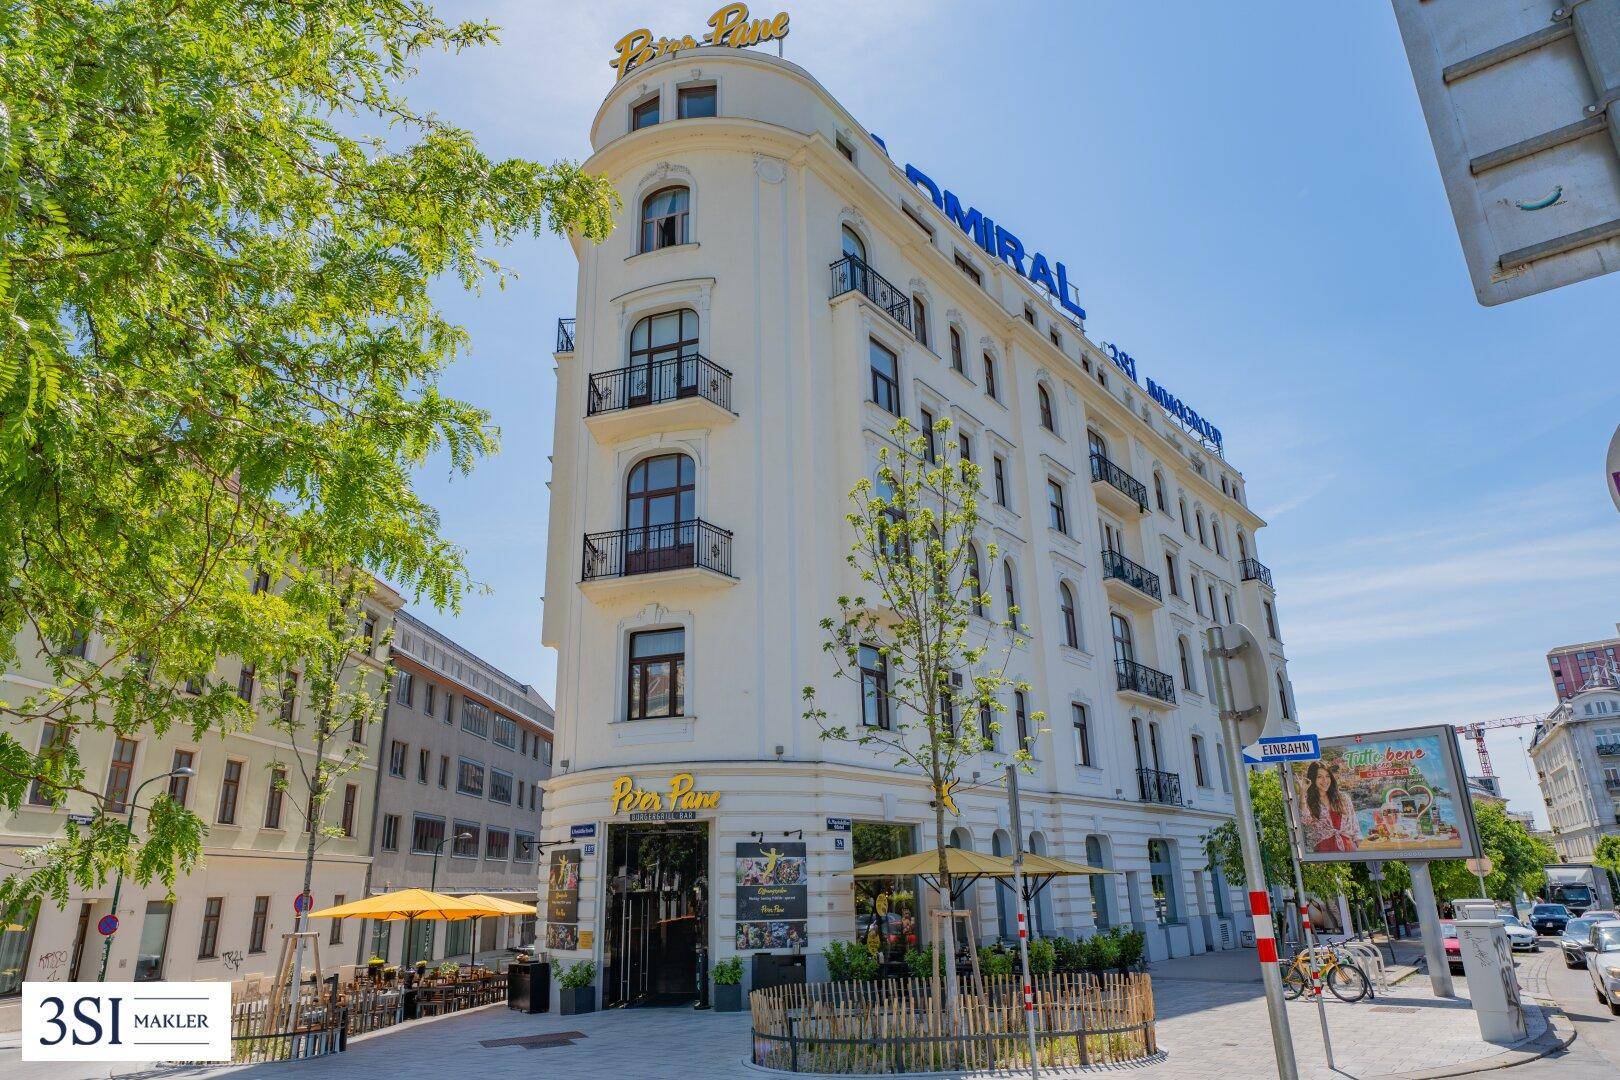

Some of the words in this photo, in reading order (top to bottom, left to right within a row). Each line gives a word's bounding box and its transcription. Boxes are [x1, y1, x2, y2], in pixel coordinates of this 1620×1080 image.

[703, 2, 790, 49] Pane
[870, 133, 1087, 320] DMIRAL
[1262, 742, 1310, 755] EINBAHN
[1343, 748, 1382, 769] Tutto
[1385, 746, 1425, 761] bene
[611, 776, 662, 816] Peter
[665, 773, 720, 812] Pane
[632, 812, 676, 820] BURGERGRILL
